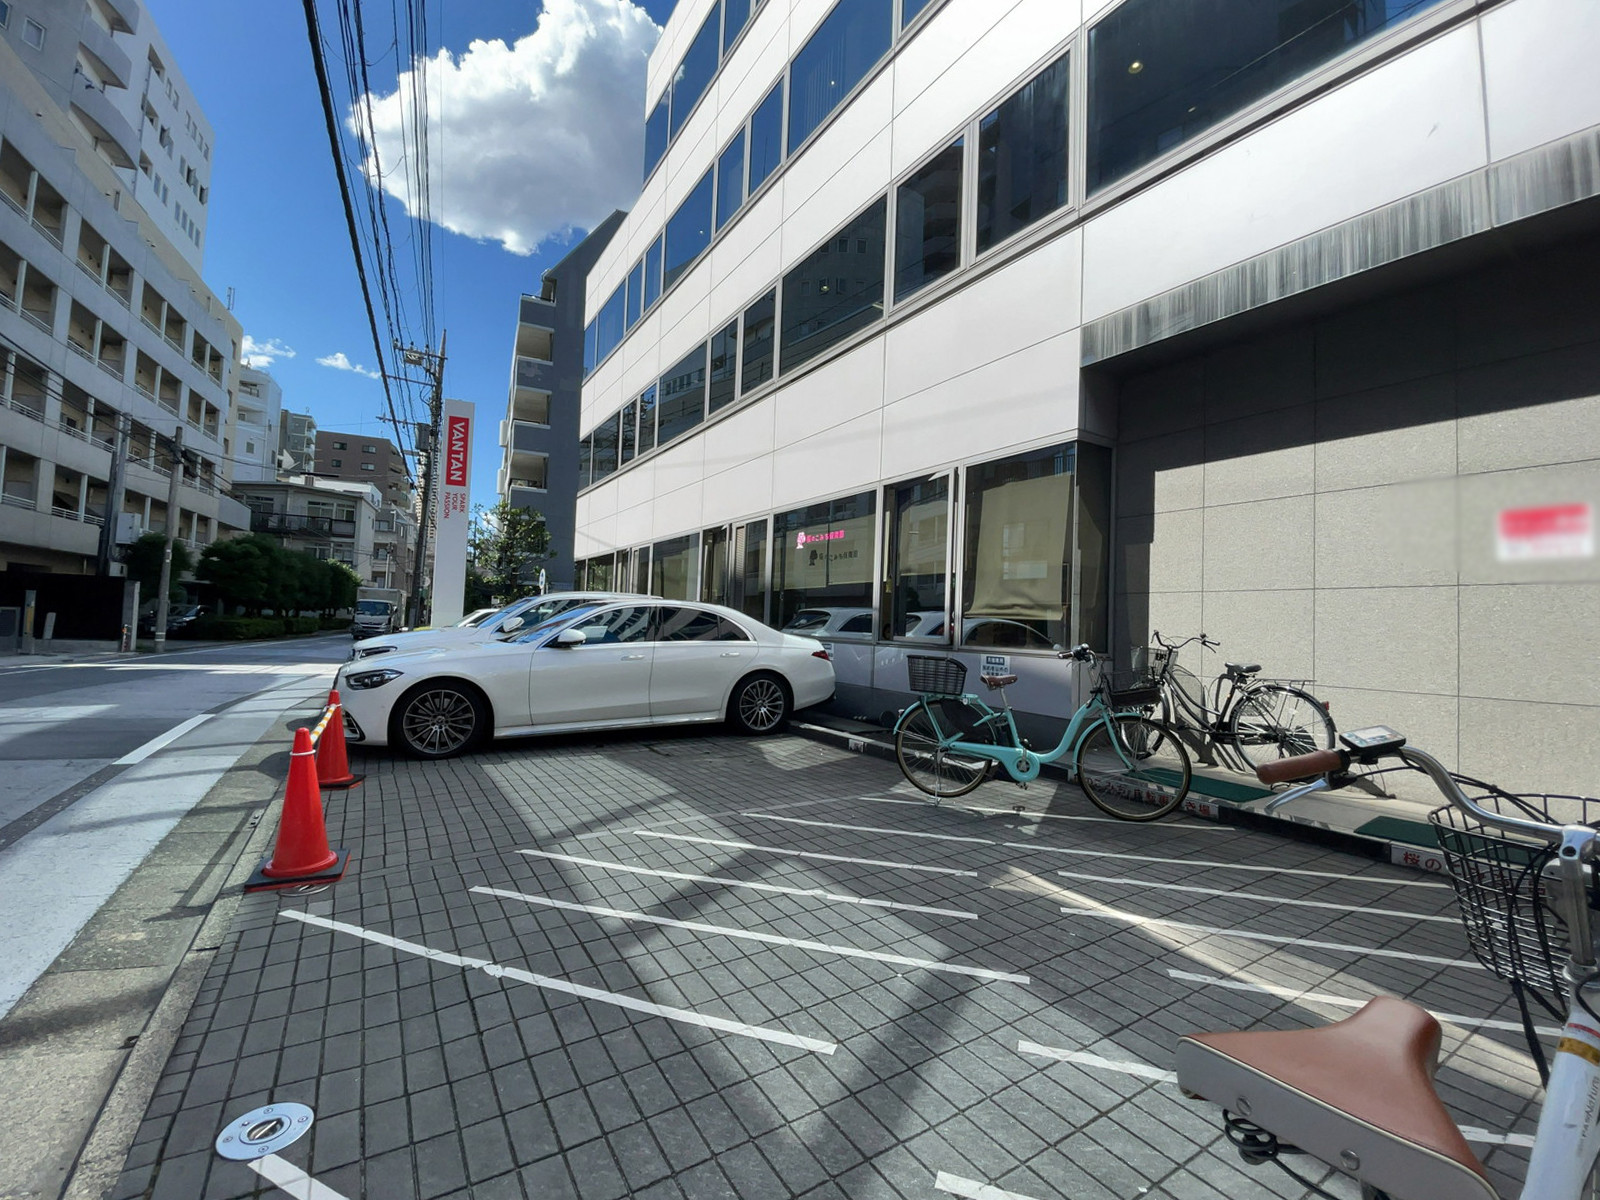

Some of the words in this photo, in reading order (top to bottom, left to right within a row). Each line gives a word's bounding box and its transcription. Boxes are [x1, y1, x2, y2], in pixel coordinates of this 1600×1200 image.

[450, 422, 466, 481] VANTAN
[443, 491, 451, 519] PASSION
[451, 492, 459, 511] YOUR
[458, 492, 466, 513] SPARK
